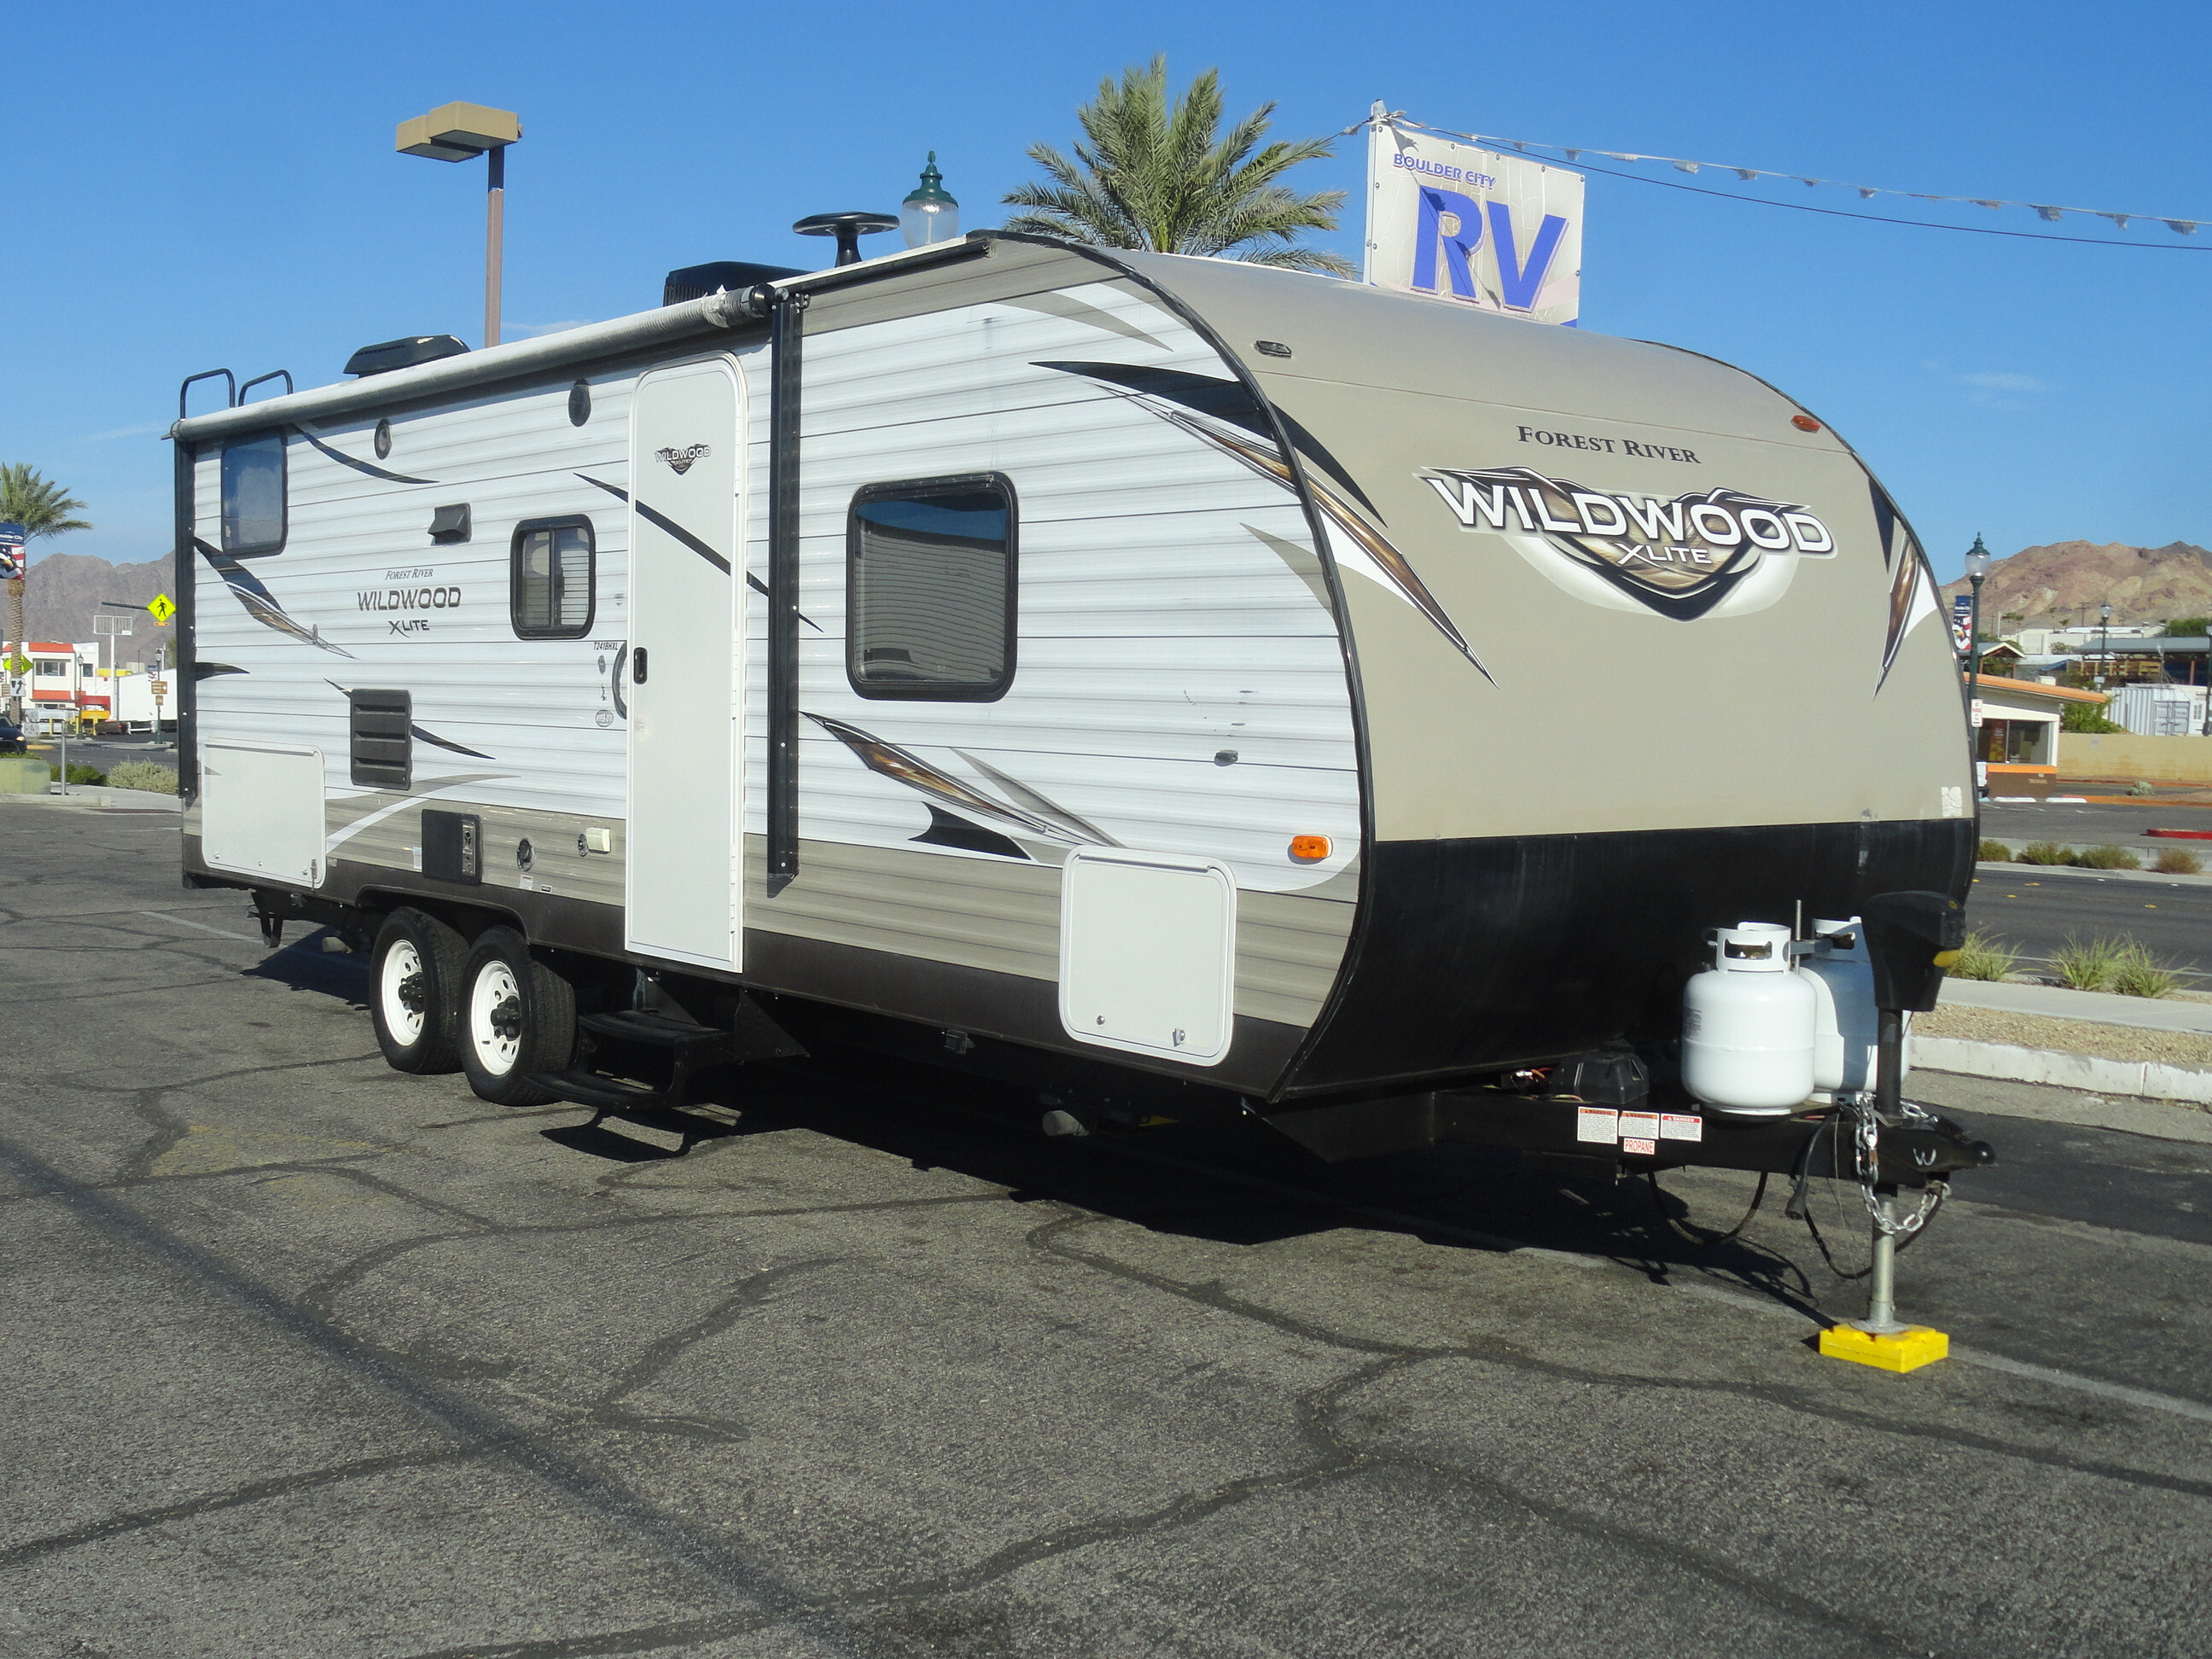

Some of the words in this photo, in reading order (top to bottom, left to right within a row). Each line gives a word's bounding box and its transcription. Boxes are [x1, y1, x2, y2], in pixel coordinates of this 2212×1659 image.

[1393, 153, 1462, 182] BOULDER
[1465, 171, 1497, 189] CITY
[1411, 184, 1570, 313] RV
[655, 446, 712, 463] WILDWOOD
[1516, 425, 1615, 453] FOREST
[1621, 439, 1702, 464] RIVER
[1424, 475, 1834, 554] WILDWOOD
[1614, 543, 1713, 568] XLITE
[385, 570, 412, 580] FOREST
[411, 568, 434, 579] RIVER
[357, 586, 461, 611] WILDWOOD
[1625, 1139, 1654, 1154] PROPANE
